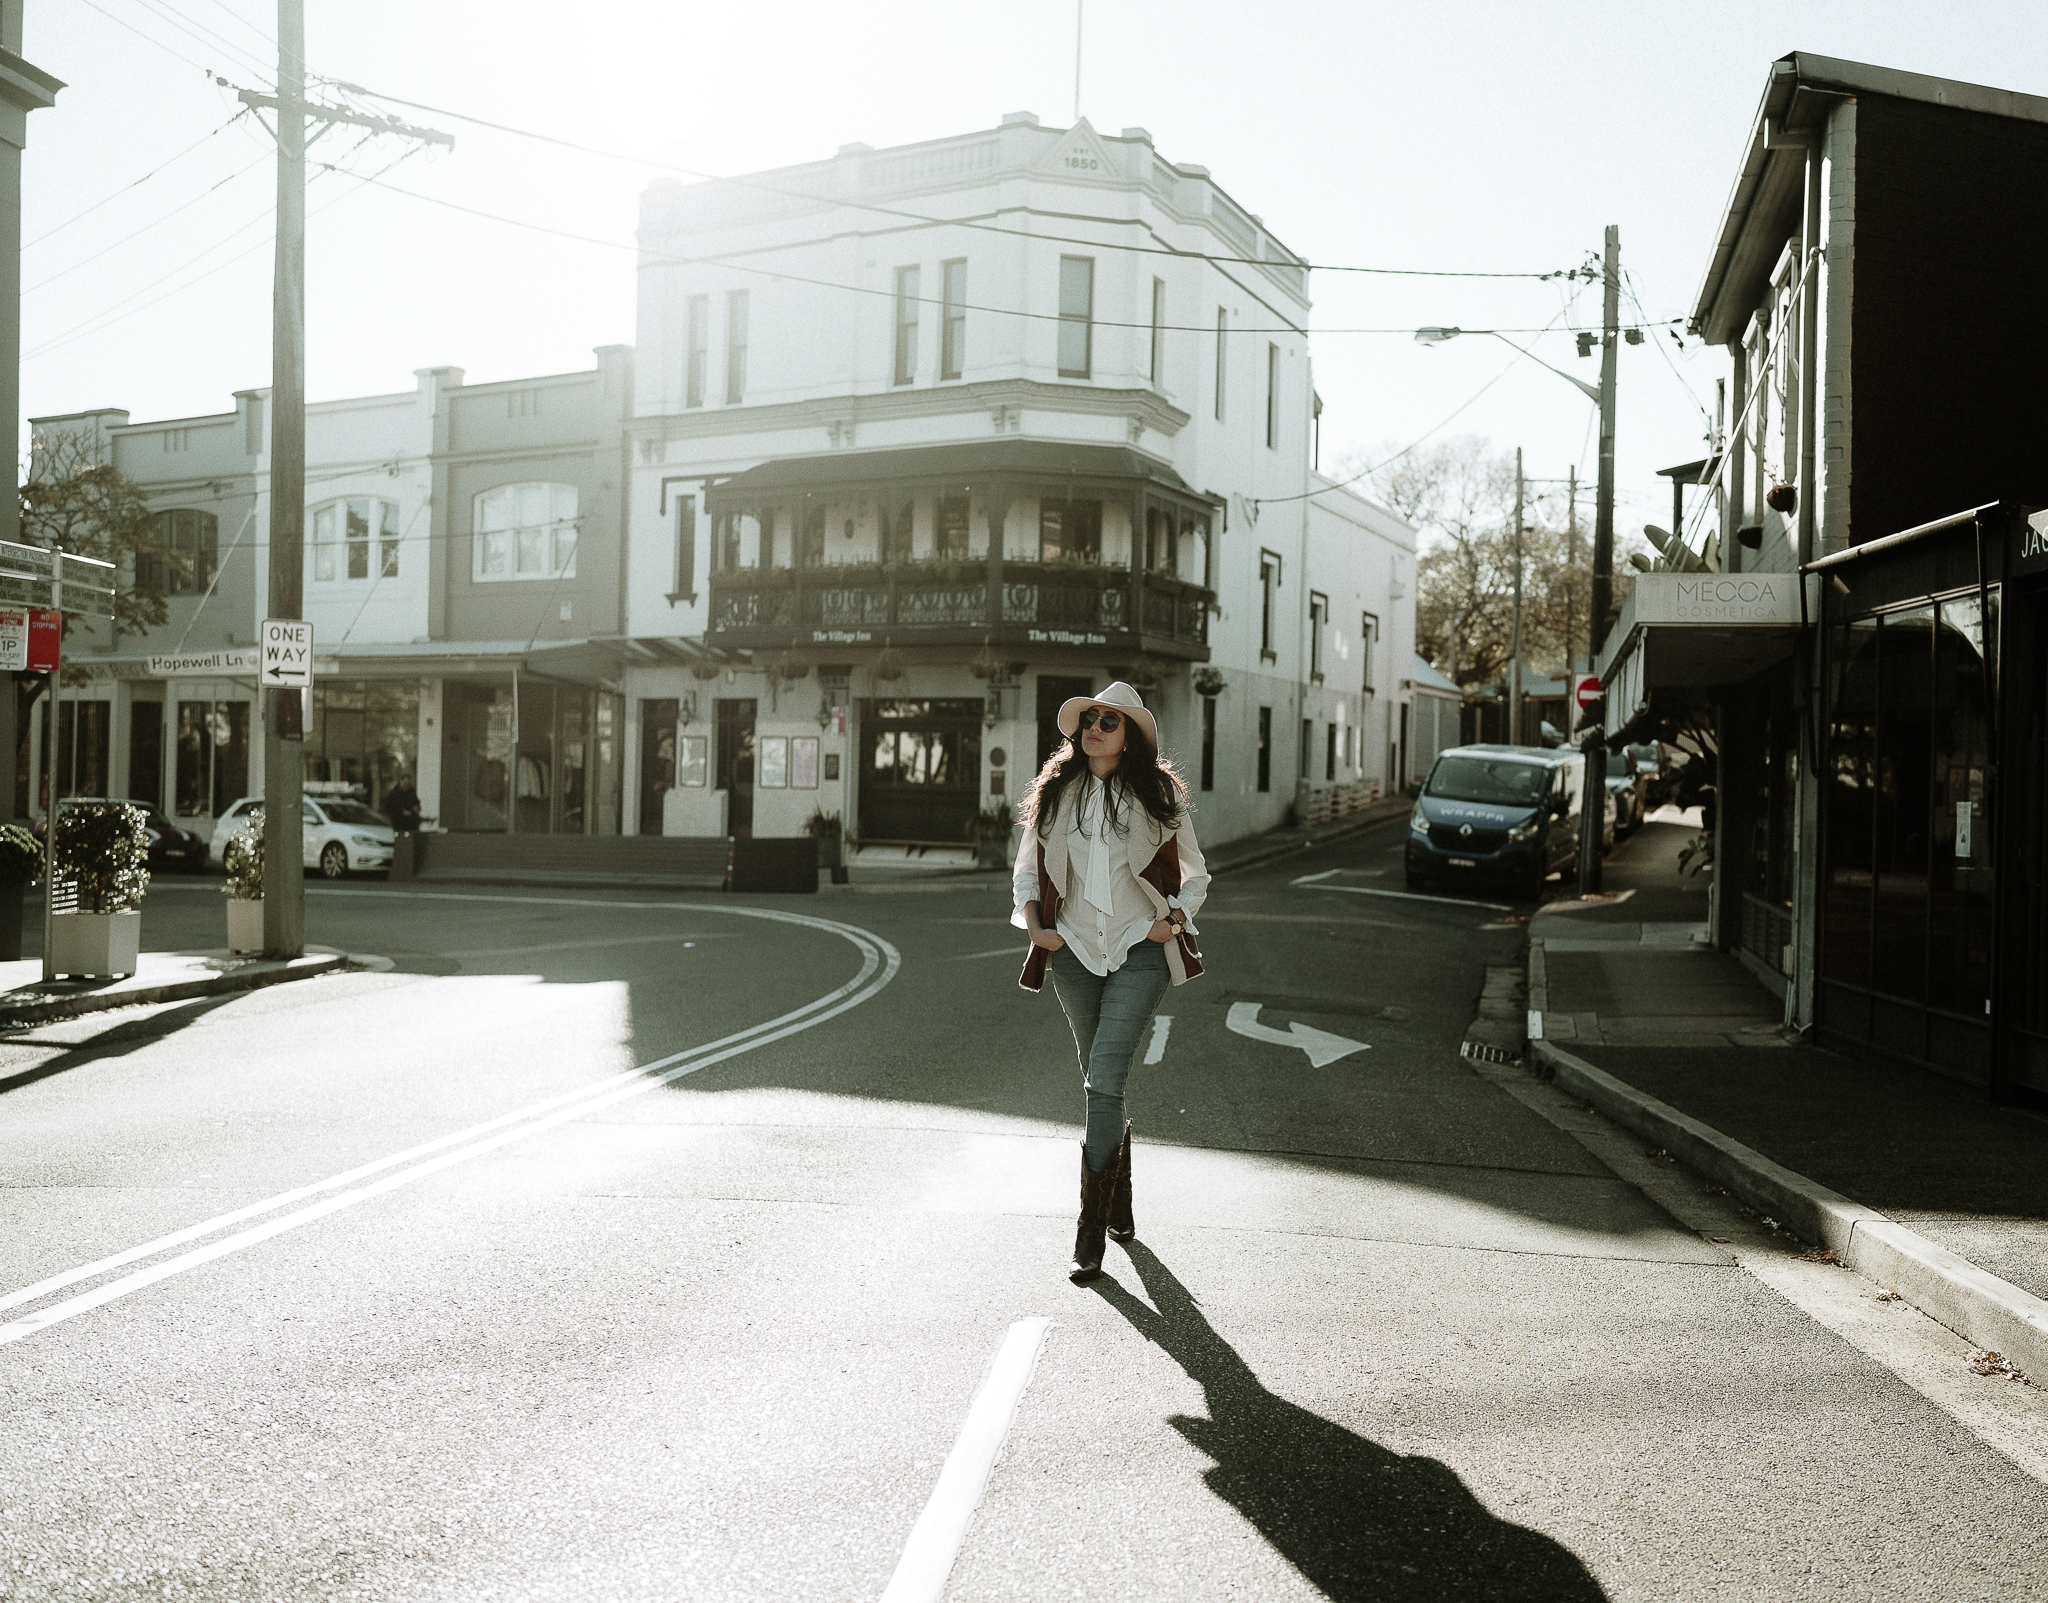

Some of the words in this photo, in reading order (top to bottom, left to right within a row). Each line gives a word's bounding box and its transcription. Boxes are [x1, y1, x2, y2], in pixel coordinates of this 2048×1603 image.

[1065, 157, 1098, 170] 1850
[1677, 581, 1776, 602] MECCA
[40, 613, 50, 621] NO
[1677, 606, 1777, 617] COSMETICA
[32, 621, 58, 630] STOPPING
[270, 626, 305, 642] ONE
[812, 630, 828, 642] The
[1027, 629, 1048, 641] The
[1048, 630, 1086, 645] Village
[1086, 632, 1107, 644] Inn
[2, 640, 17, 651] 1P
[267, 647, 307, 662] WAY
[152, 655, 220, 671] Hopewell
[226, 654, 243, 667] Ln
